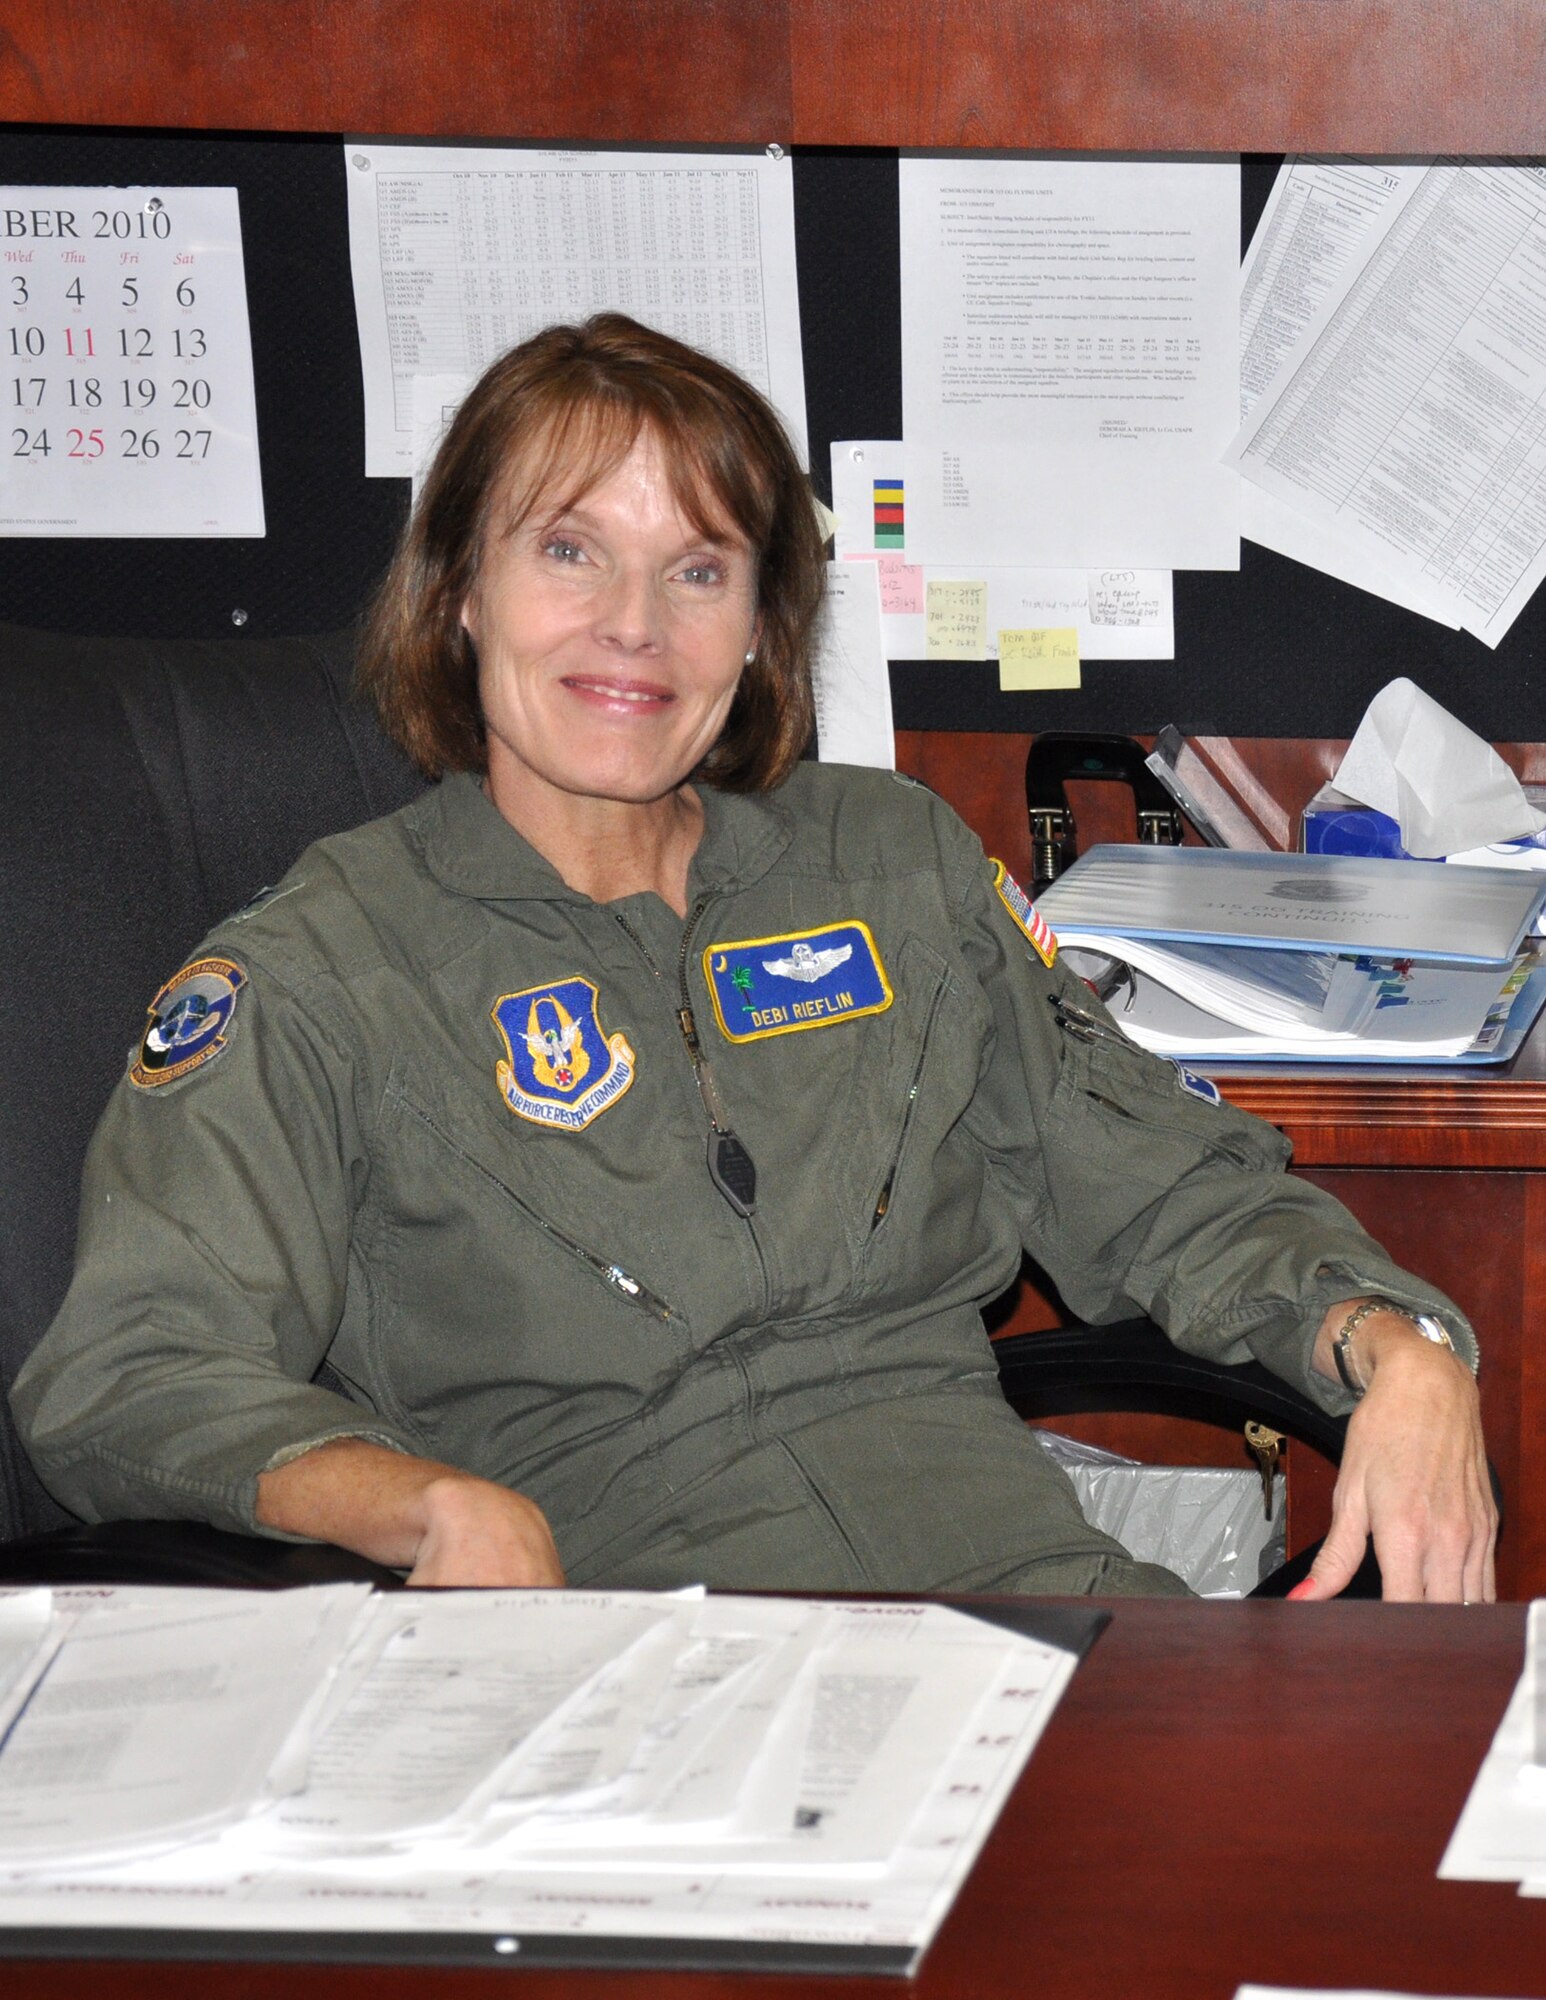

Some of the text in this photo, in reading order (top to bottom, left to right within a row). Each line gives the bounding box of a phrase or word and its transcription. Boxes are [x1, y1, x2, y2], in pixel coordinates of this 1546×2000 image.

[0, 208, 173, 241] BER 2010
[4, 249, 195, 267] Wed Thu Fri Sat
[12, 276, 195, 307] 3 4 5 6
[10, 327, 206, 357] 10 11 12 13
[13, 378, 211, 408] 17 18 19 20
[12, 428, 212, 458] 24 25 26 27
[1228, 911, 1374, 924] CONTINUITY
[1299, 907, 1409, 920] TRAINING
[751, 992, 854, 1027] DEBI RIEFLIN
[508, 1062, 630, 1127] AIR FORCE RESERVE COMMAND
